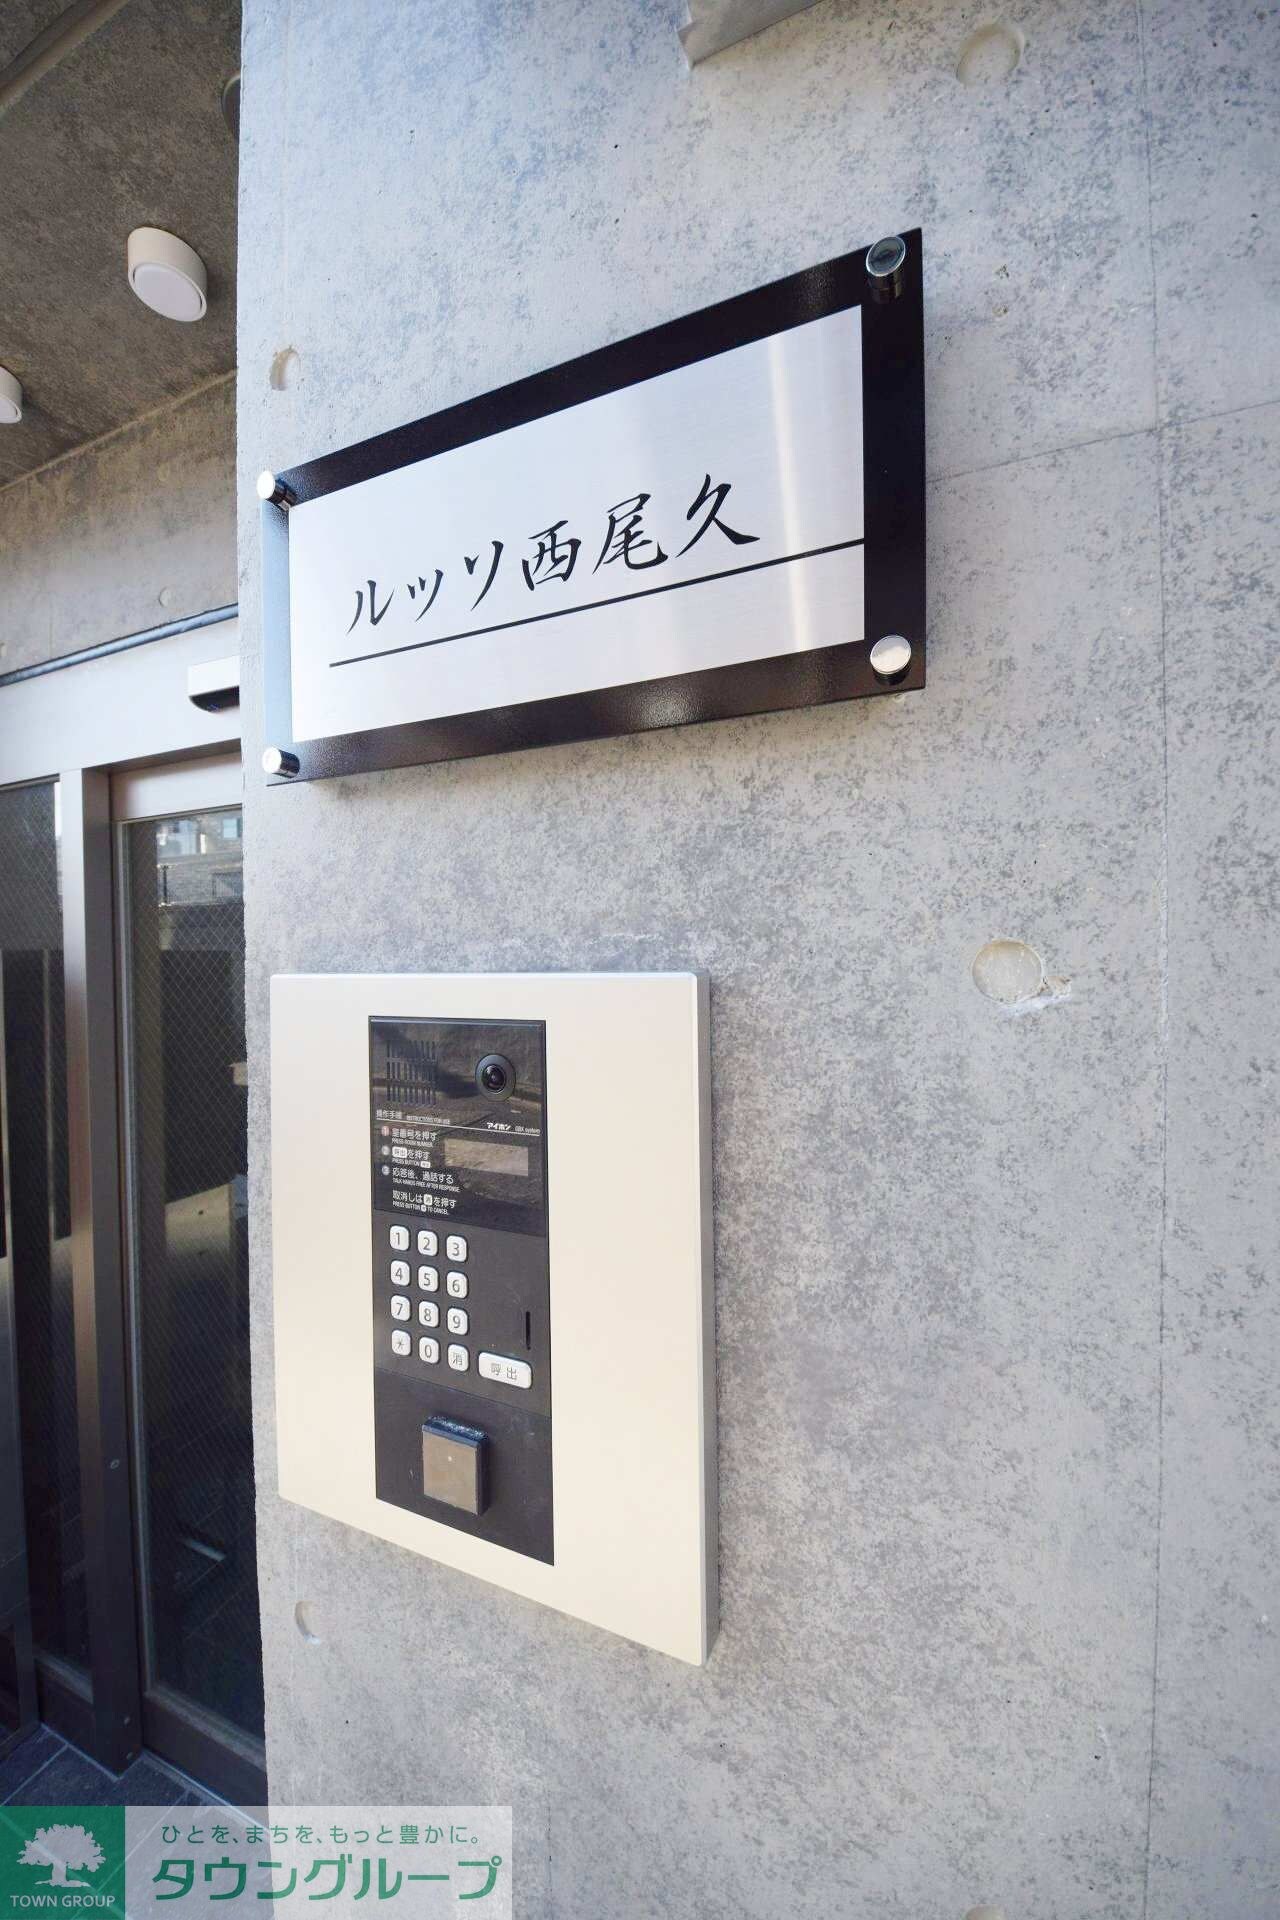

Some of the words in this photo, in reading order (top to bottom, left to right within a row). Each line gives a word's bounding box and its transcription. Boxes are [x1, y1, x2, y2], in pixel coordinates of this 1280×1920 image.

[346, 472, 761, 636] ルッソ西尾久
[486, 1122, 511, 1131] アイホン
[396, 1232, 401, 1245] 1
[423, 1237, 430, 1251] 2
[452, 1242, 459, 1257] 3
[395, 1267, 403, 1281] 4
[423, 1273, 430, 1287] 5
[452, 1279, 460, 1293] 6
[396, 1302, 403, 1316] 7
[423, 1308, 431, 1322] 8
[452, 1315, 460, 1329] 9
[424, 1344, 432, 1359] 0
